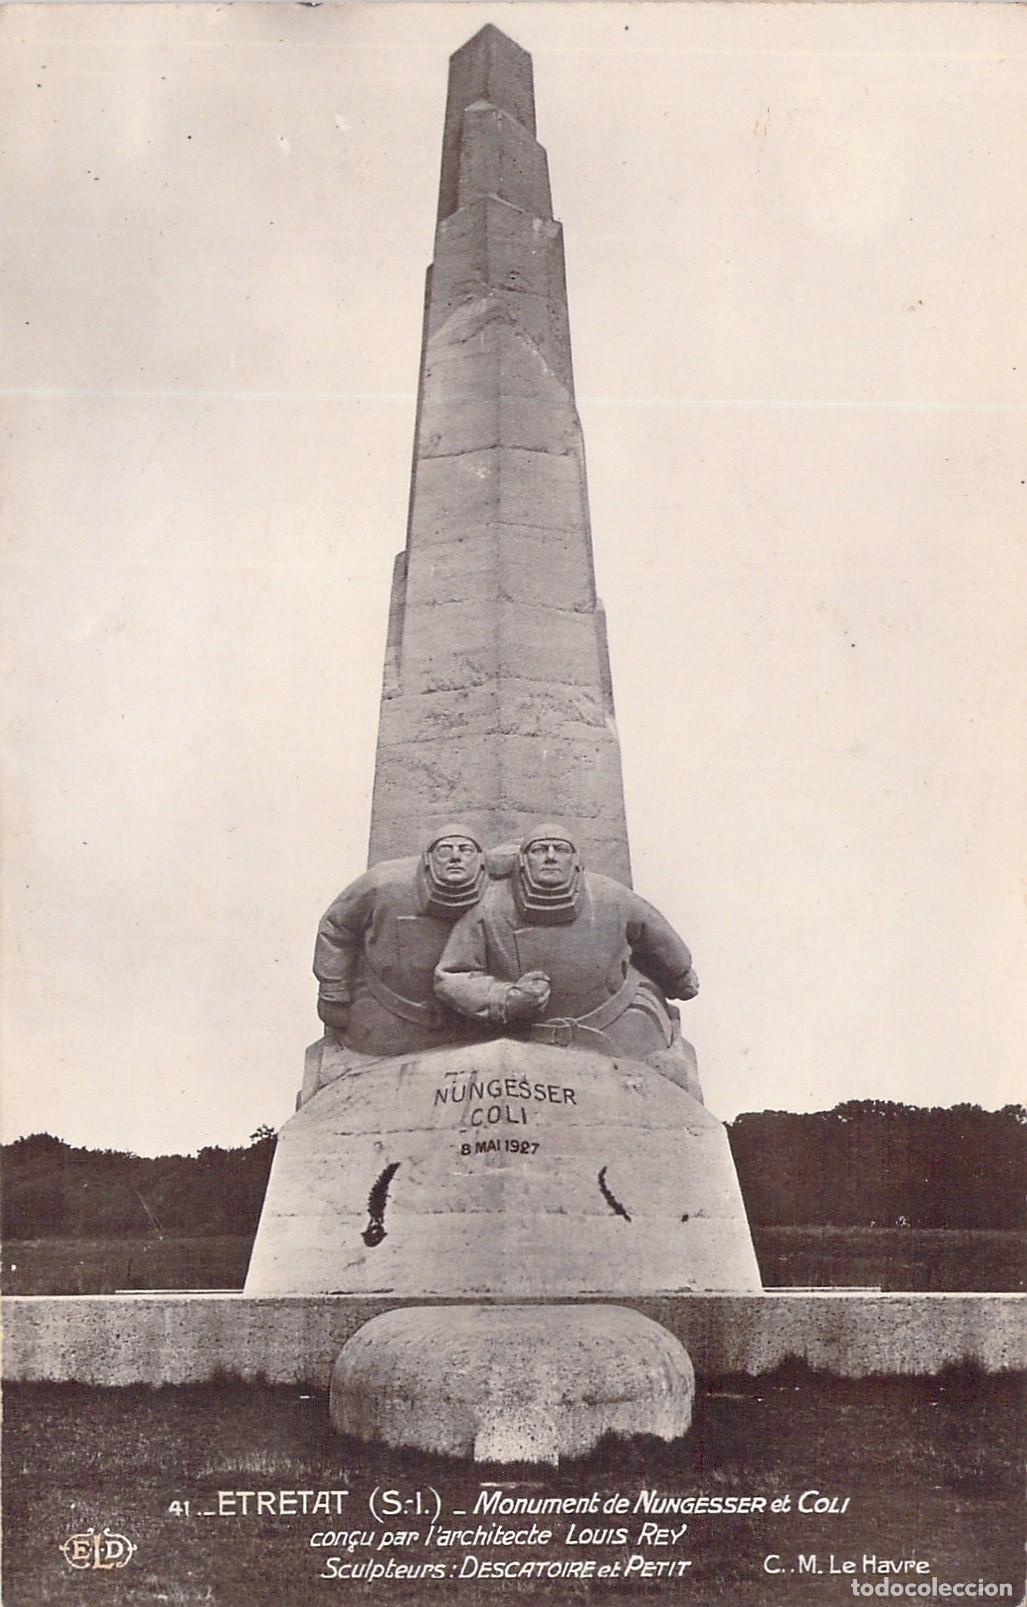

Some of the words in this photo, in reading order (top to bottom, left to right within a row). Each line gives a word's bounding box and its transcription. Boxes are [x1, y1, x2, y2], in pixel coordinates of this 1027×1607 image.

[434, 1078, 577, 1107] NUNGESSER
[471, 1104, 528, 1127] COLI
[460, 1143, 471, 1156] 8
[475, 1139, 501, 1154] MAI
[505, 1139, 540, 1155] 1927
